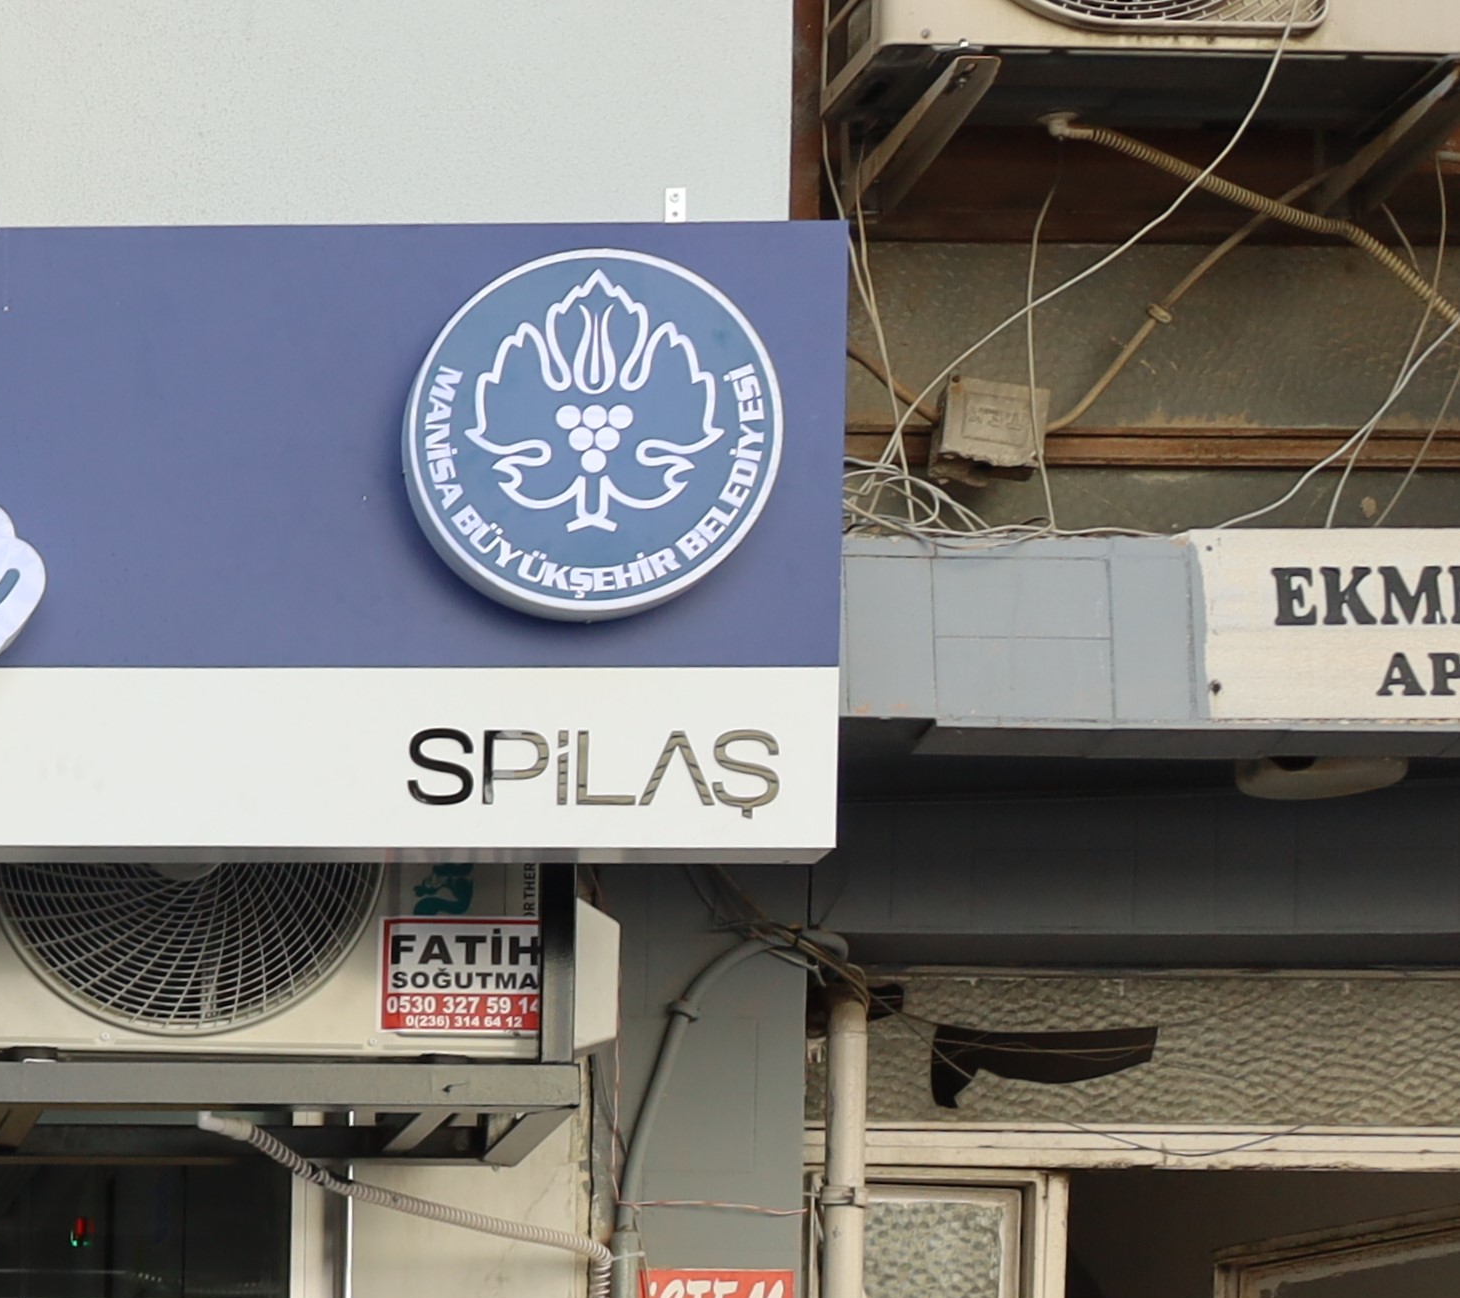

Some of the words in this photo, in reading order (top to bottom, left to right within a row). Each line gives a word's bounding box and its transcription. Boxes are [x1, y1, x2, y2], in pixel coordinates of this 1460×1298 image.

[424, 364, 464, 511] MANİSA
[450, 504, 682, 599] BÜYÜKŞEHİR
[674, 362, 766, 561] BELEDİYESİ
[390, 928, 540, 966] FATİH
[391, 968, 540, 990] SOĞUTMA
[386, 995, 437, 1014] 0530
[442, 996, 480, 1014] 327
[486, 997, 512, 1015] 59
[405, 1015, 450, 1031] 0(236)
[454, 1016, 480, 1028] 314
[484, 1016, 502, 1028] 64
[506, 1016, 523, 1029] 12
